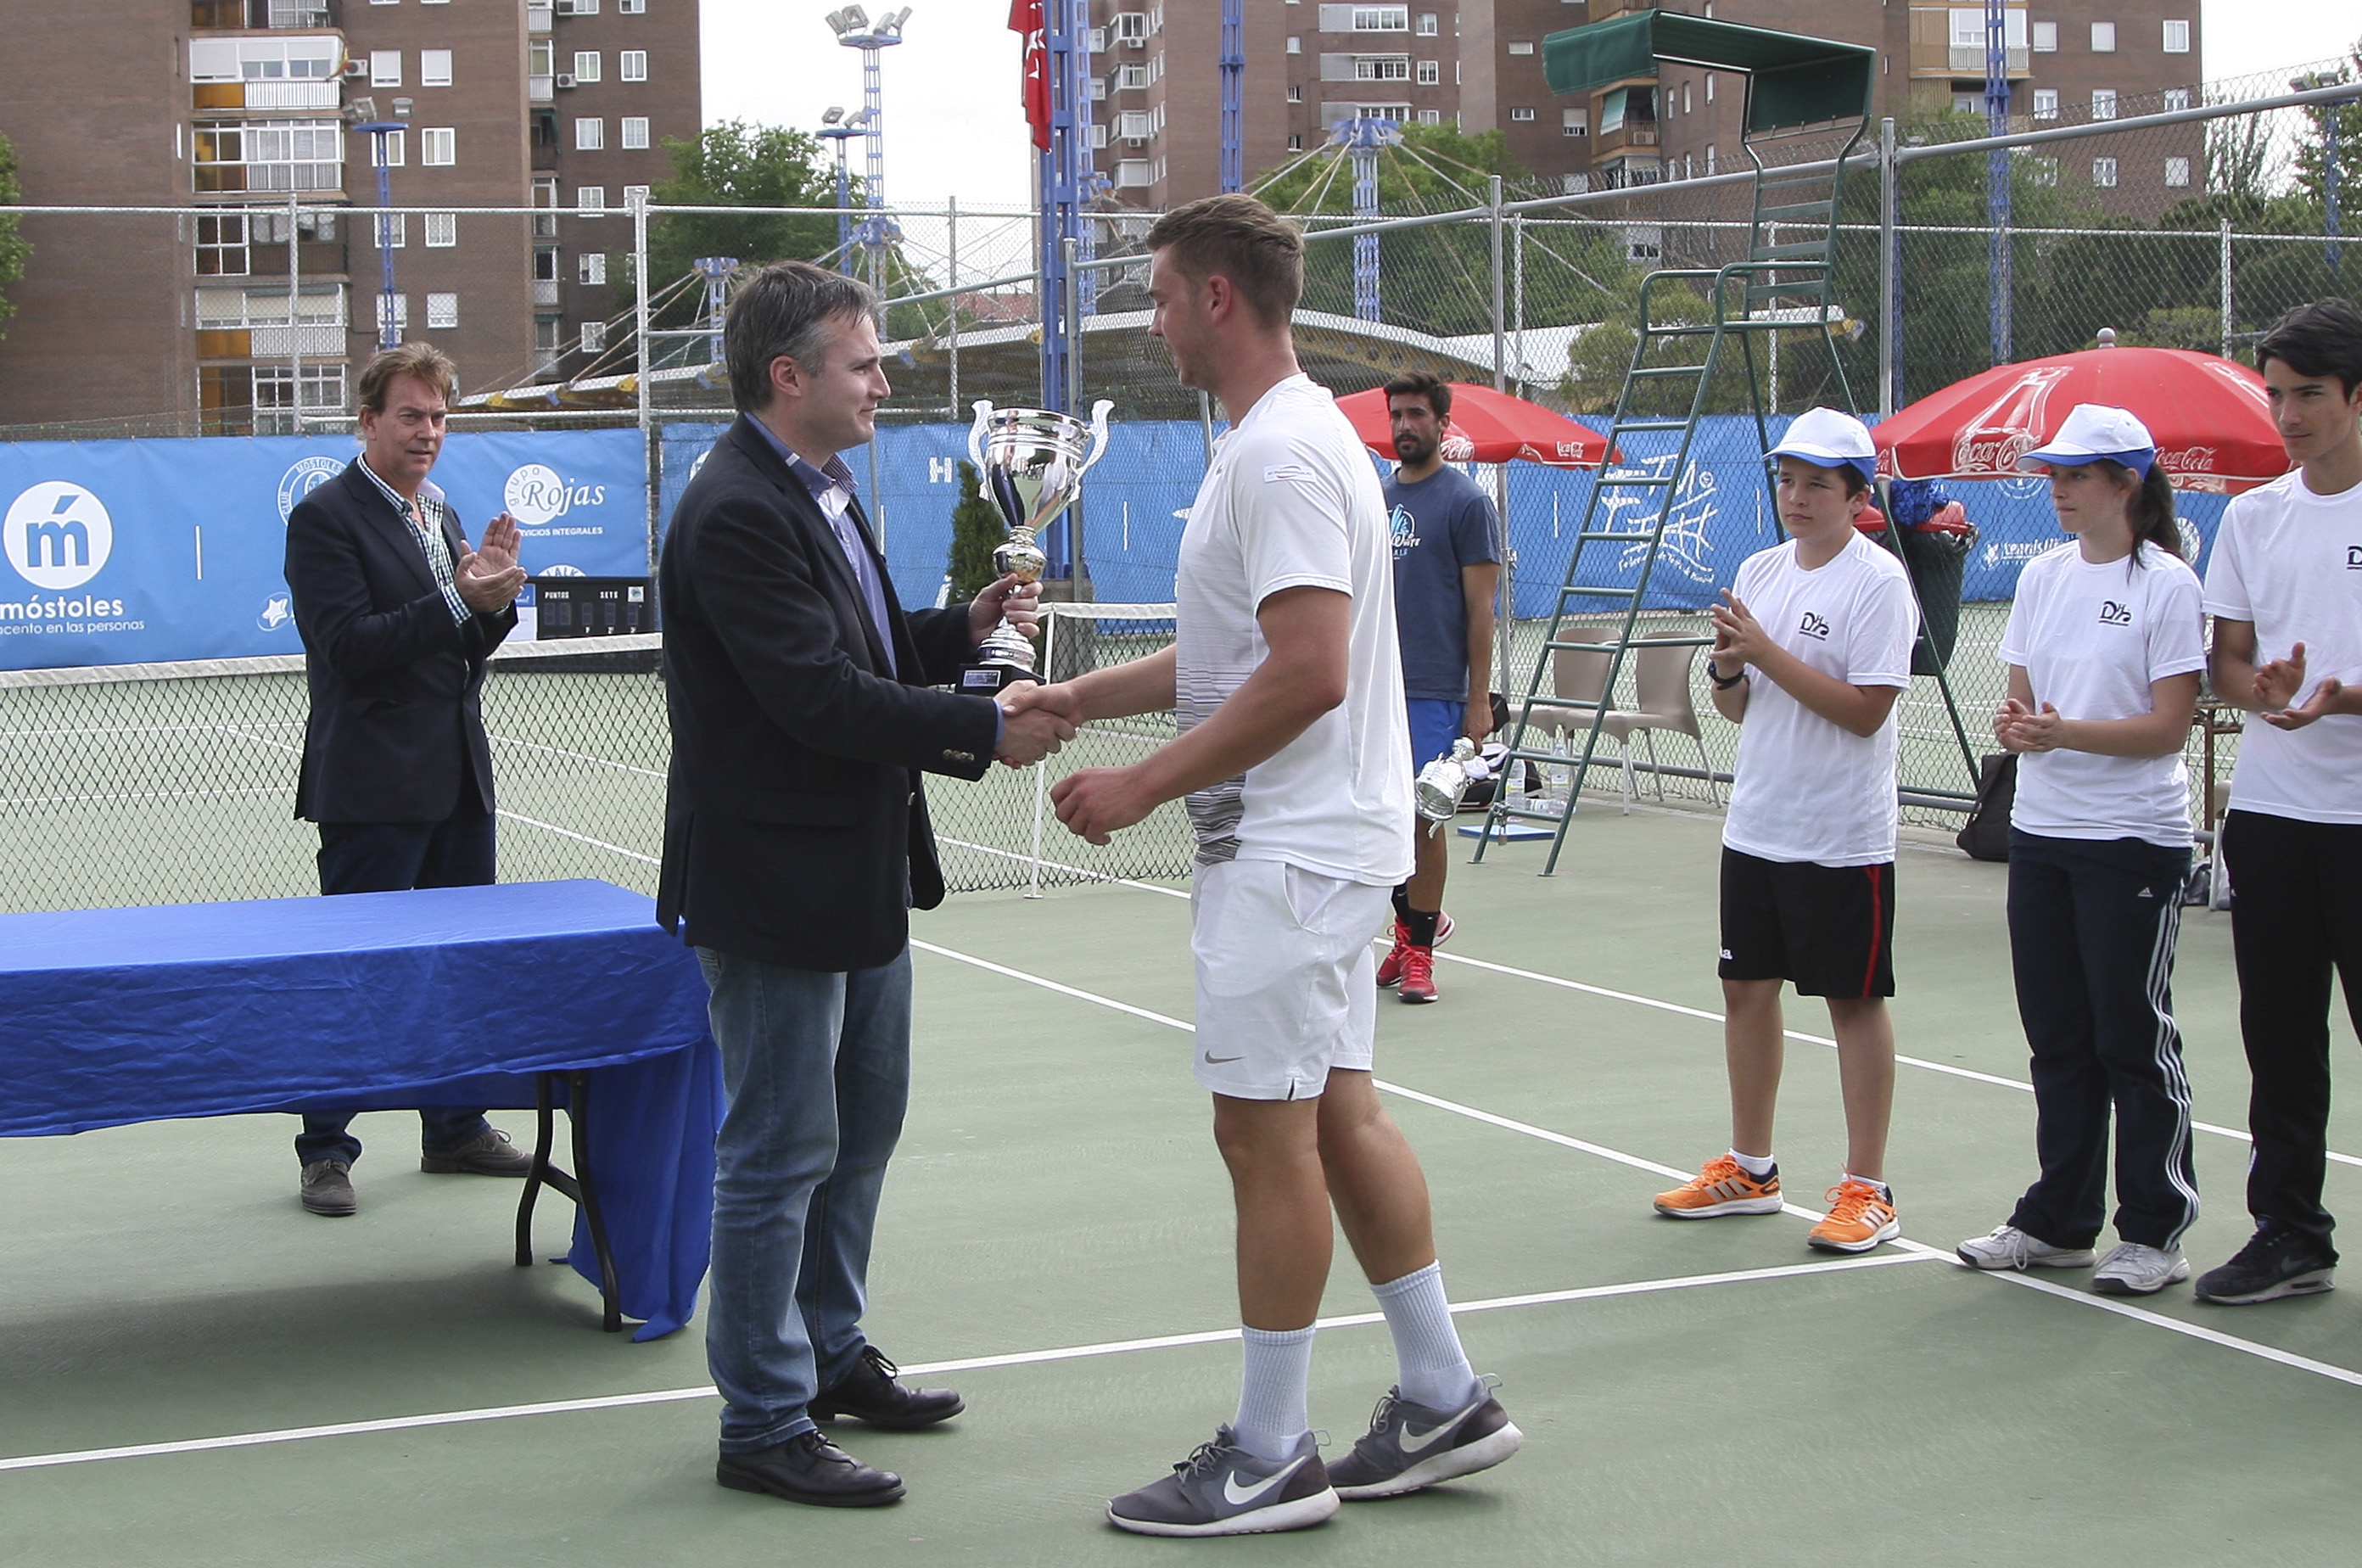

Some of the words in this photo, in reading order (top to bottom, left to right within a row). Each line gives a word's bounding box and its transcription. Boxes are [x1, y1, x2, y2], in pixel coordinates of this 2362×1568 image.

[508, 466, 540, 507] grupo
[521, 477, 606, 517] Rojas
[520, 528, 551, 537] RVICIOS
[552, 526, 604, 536] INTEGRALES
[0, 594, 124, 620] móstoles
[46, 623, 64, 634] en
[66, 621, 84, 632] las
[87, 619, 145, 634] personas
